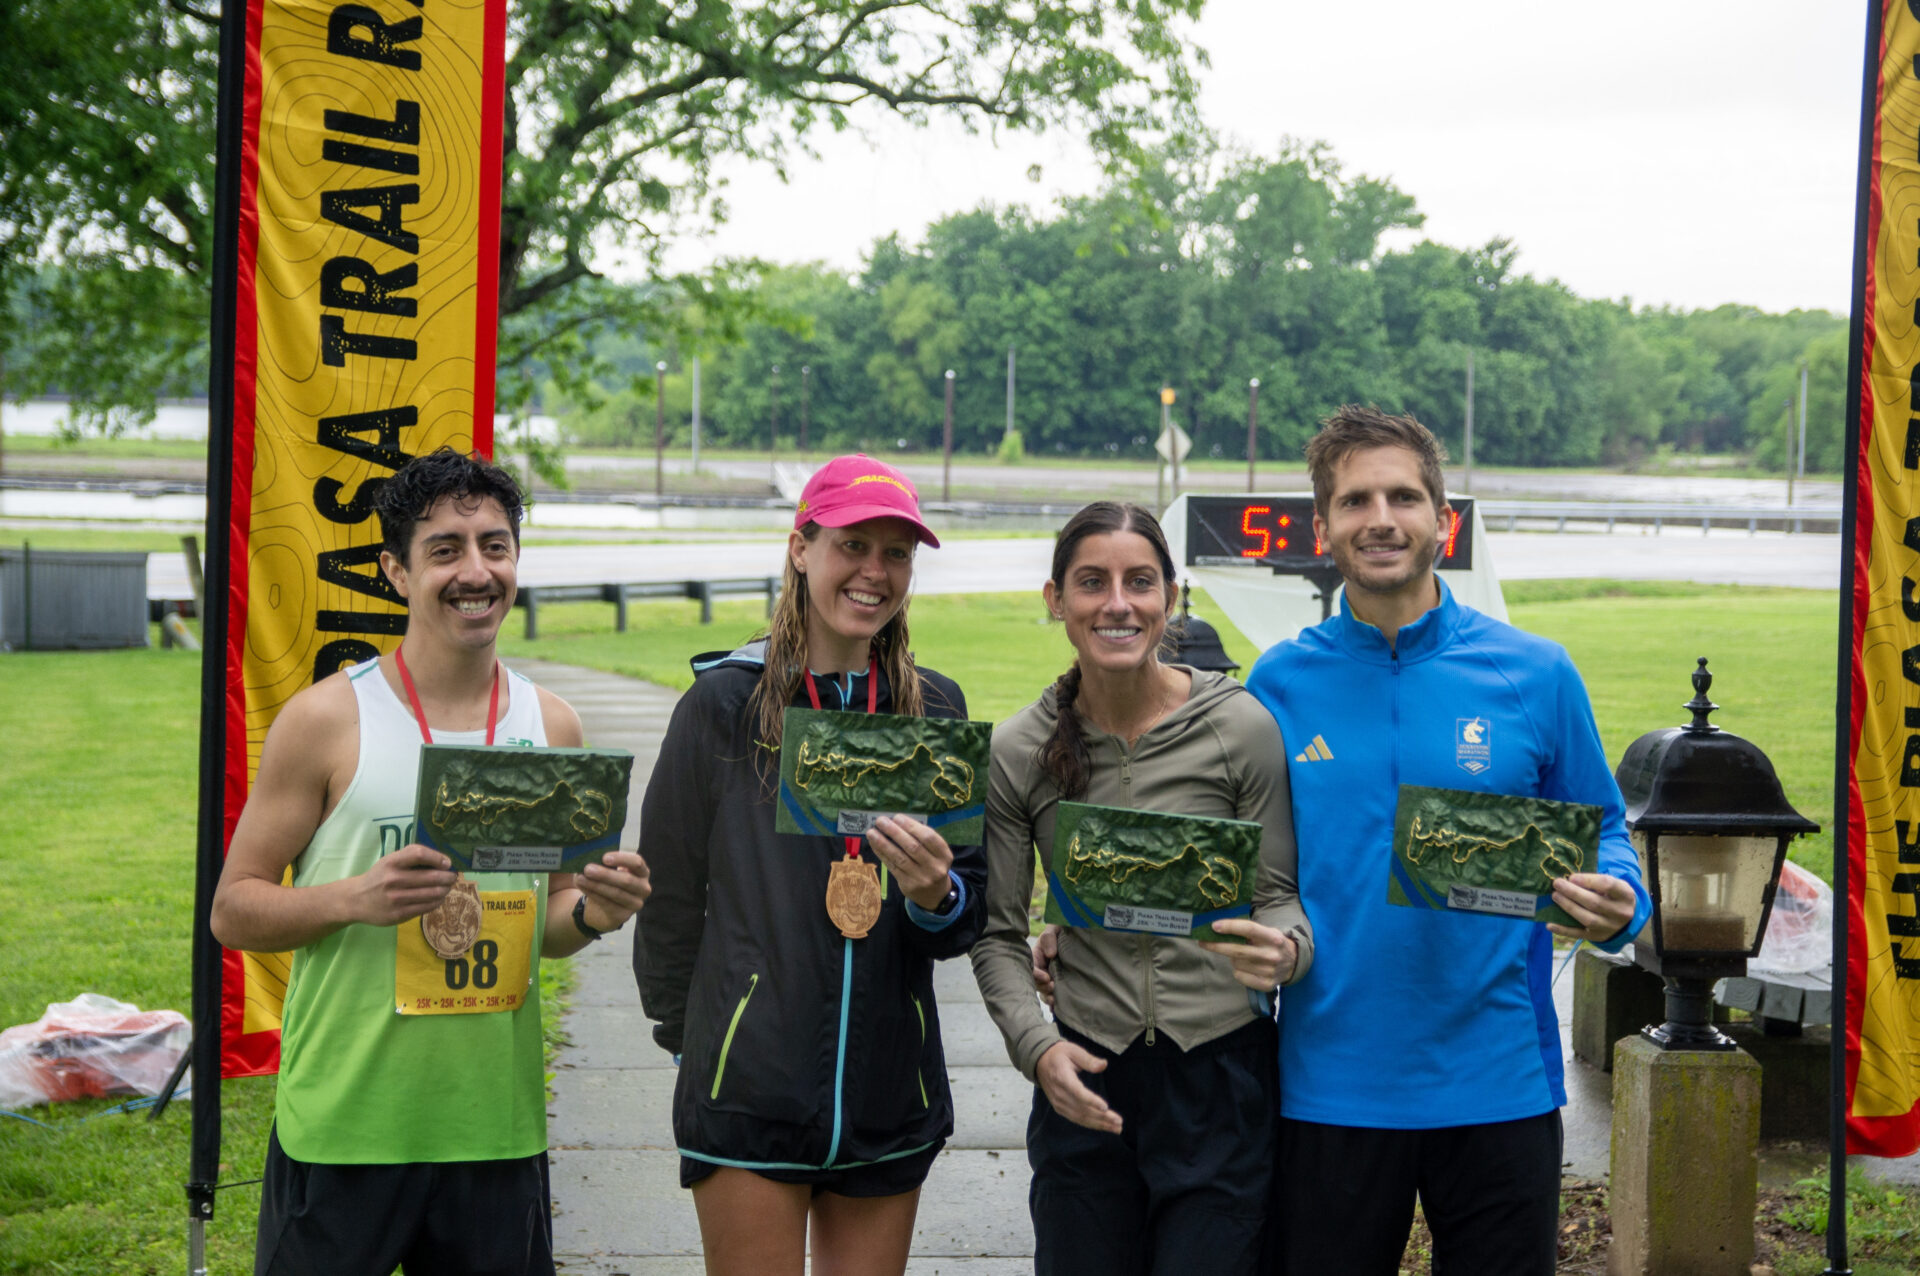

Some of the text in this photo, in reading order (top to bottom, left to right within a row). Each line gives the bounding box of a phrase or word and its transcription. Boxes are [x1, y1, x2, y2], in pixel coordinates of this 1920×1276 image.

[319, 99, 421, 367] TRAIL
[486, 900, 507, 911] TRAIL
[507, 899, 526, 911] RACES
[444, 939, 498, 990] 68
[416, 994, 517, 1009] 25K 25K 25K 25K 25K
